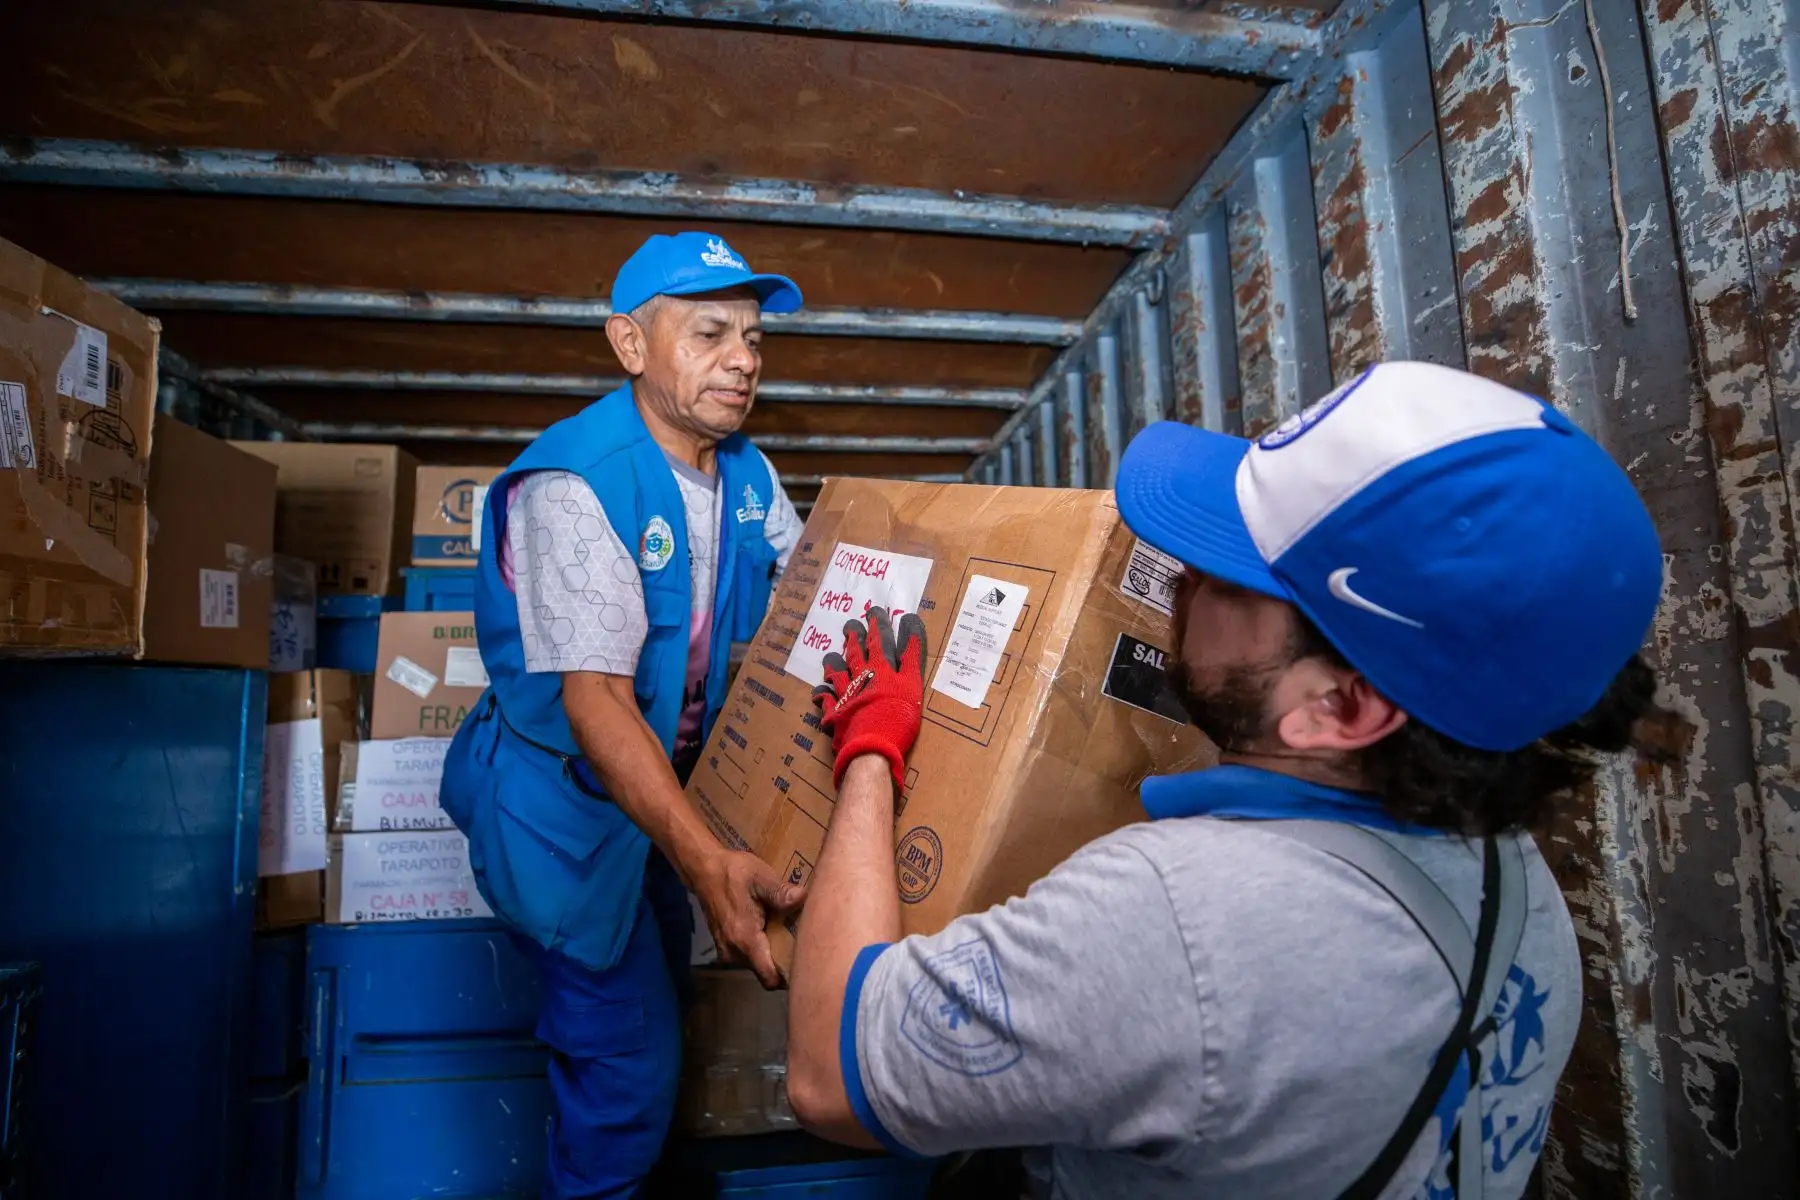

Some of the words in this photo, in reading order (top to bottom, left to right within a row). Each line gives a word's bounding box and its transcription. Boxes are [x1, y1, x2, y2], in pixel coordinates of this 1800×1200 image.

[820, 590, 853, 612] CAMPO
[803, 625, 832, 651] CAMPO
[379, 816, 457, 831] BISMUT
[377, 838, 464, 855] OPERATIVO
[380, 857, 461, 873] TARAPOTO
[906, 844, 933, 872] BPM
[902, 871, 919, 888] GMP
[370, 894, 417, 910] CAJA
